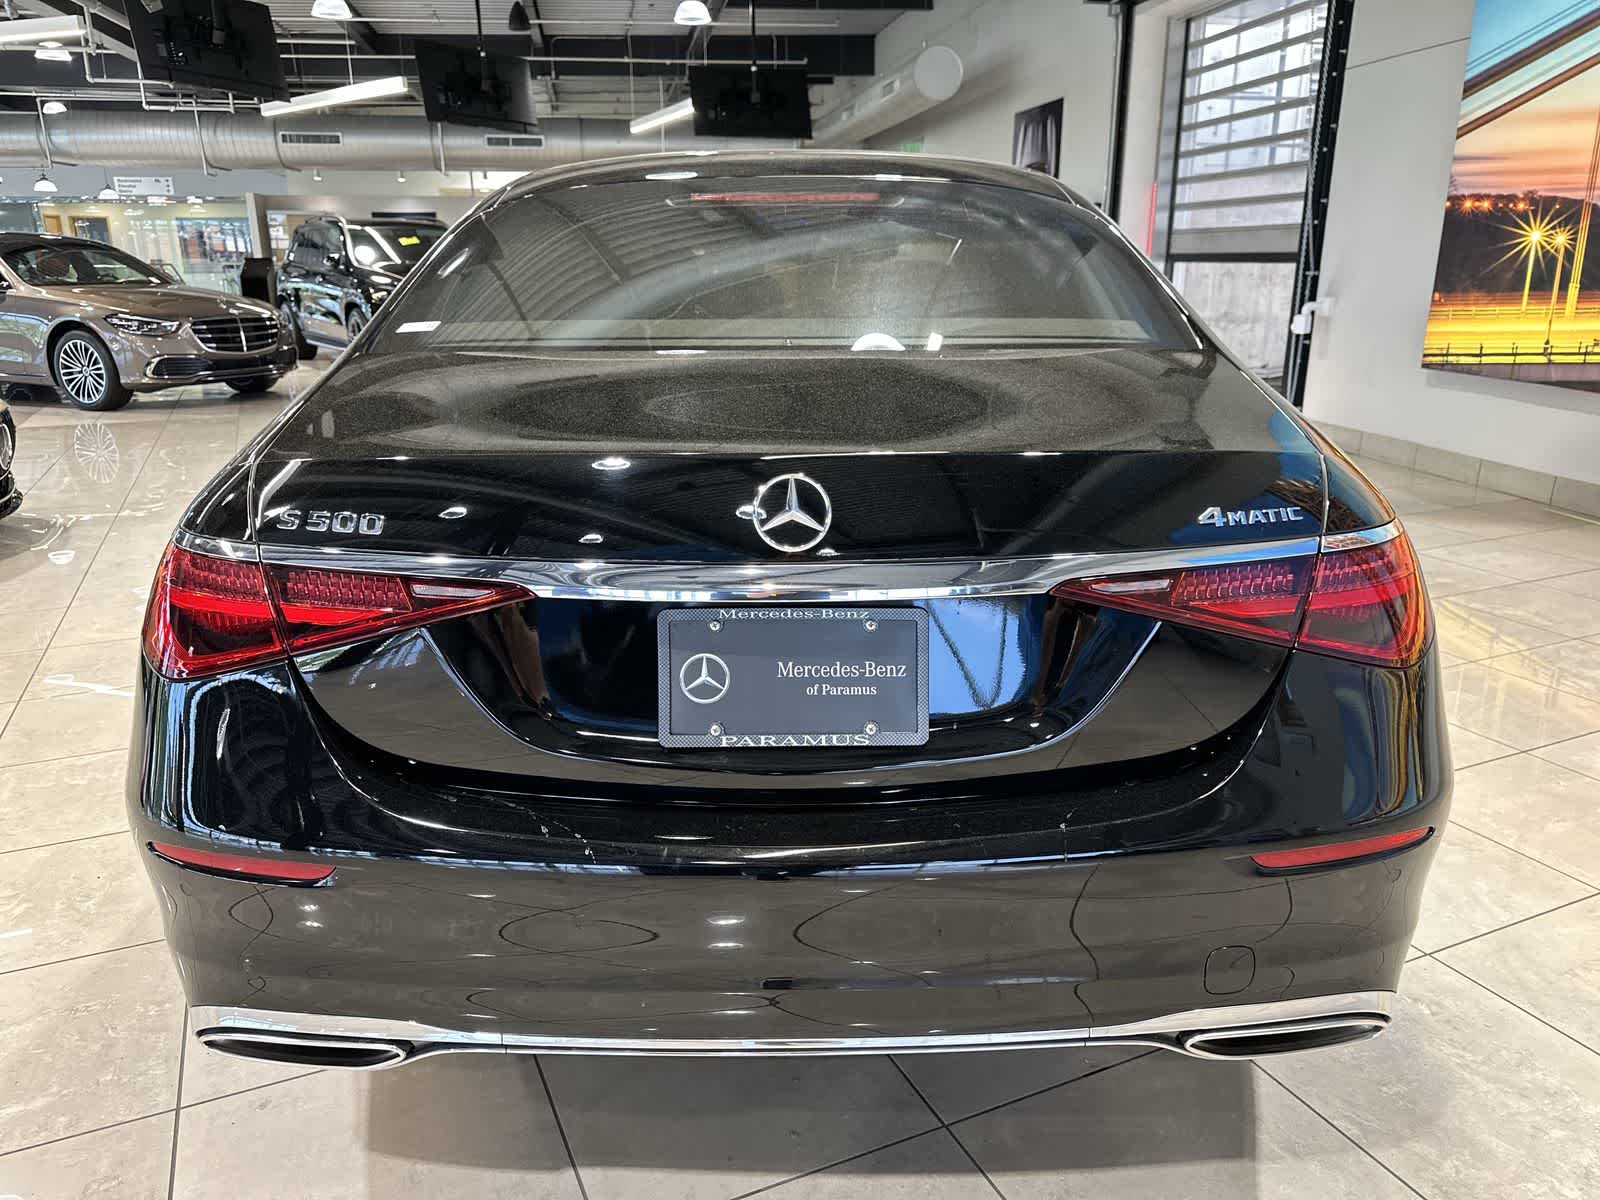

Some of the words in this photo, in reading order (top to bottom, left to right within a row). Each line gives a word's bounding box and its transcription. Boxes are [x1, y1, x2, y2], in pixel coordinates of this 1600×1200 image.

[276, 509, 301, 530] S
[305, 510, 385, 535] 500
[1198, 507, 1303, 527] 4MATIC
[718, 609, 870, 620] Mercedes-Benz
[777, 661, 907, 678] Mercedes-Benz
[806, 684, 819, 695] of
[822, 684, 877, 695] Paramus
[720, 734, 870, 747] PARAMUS
